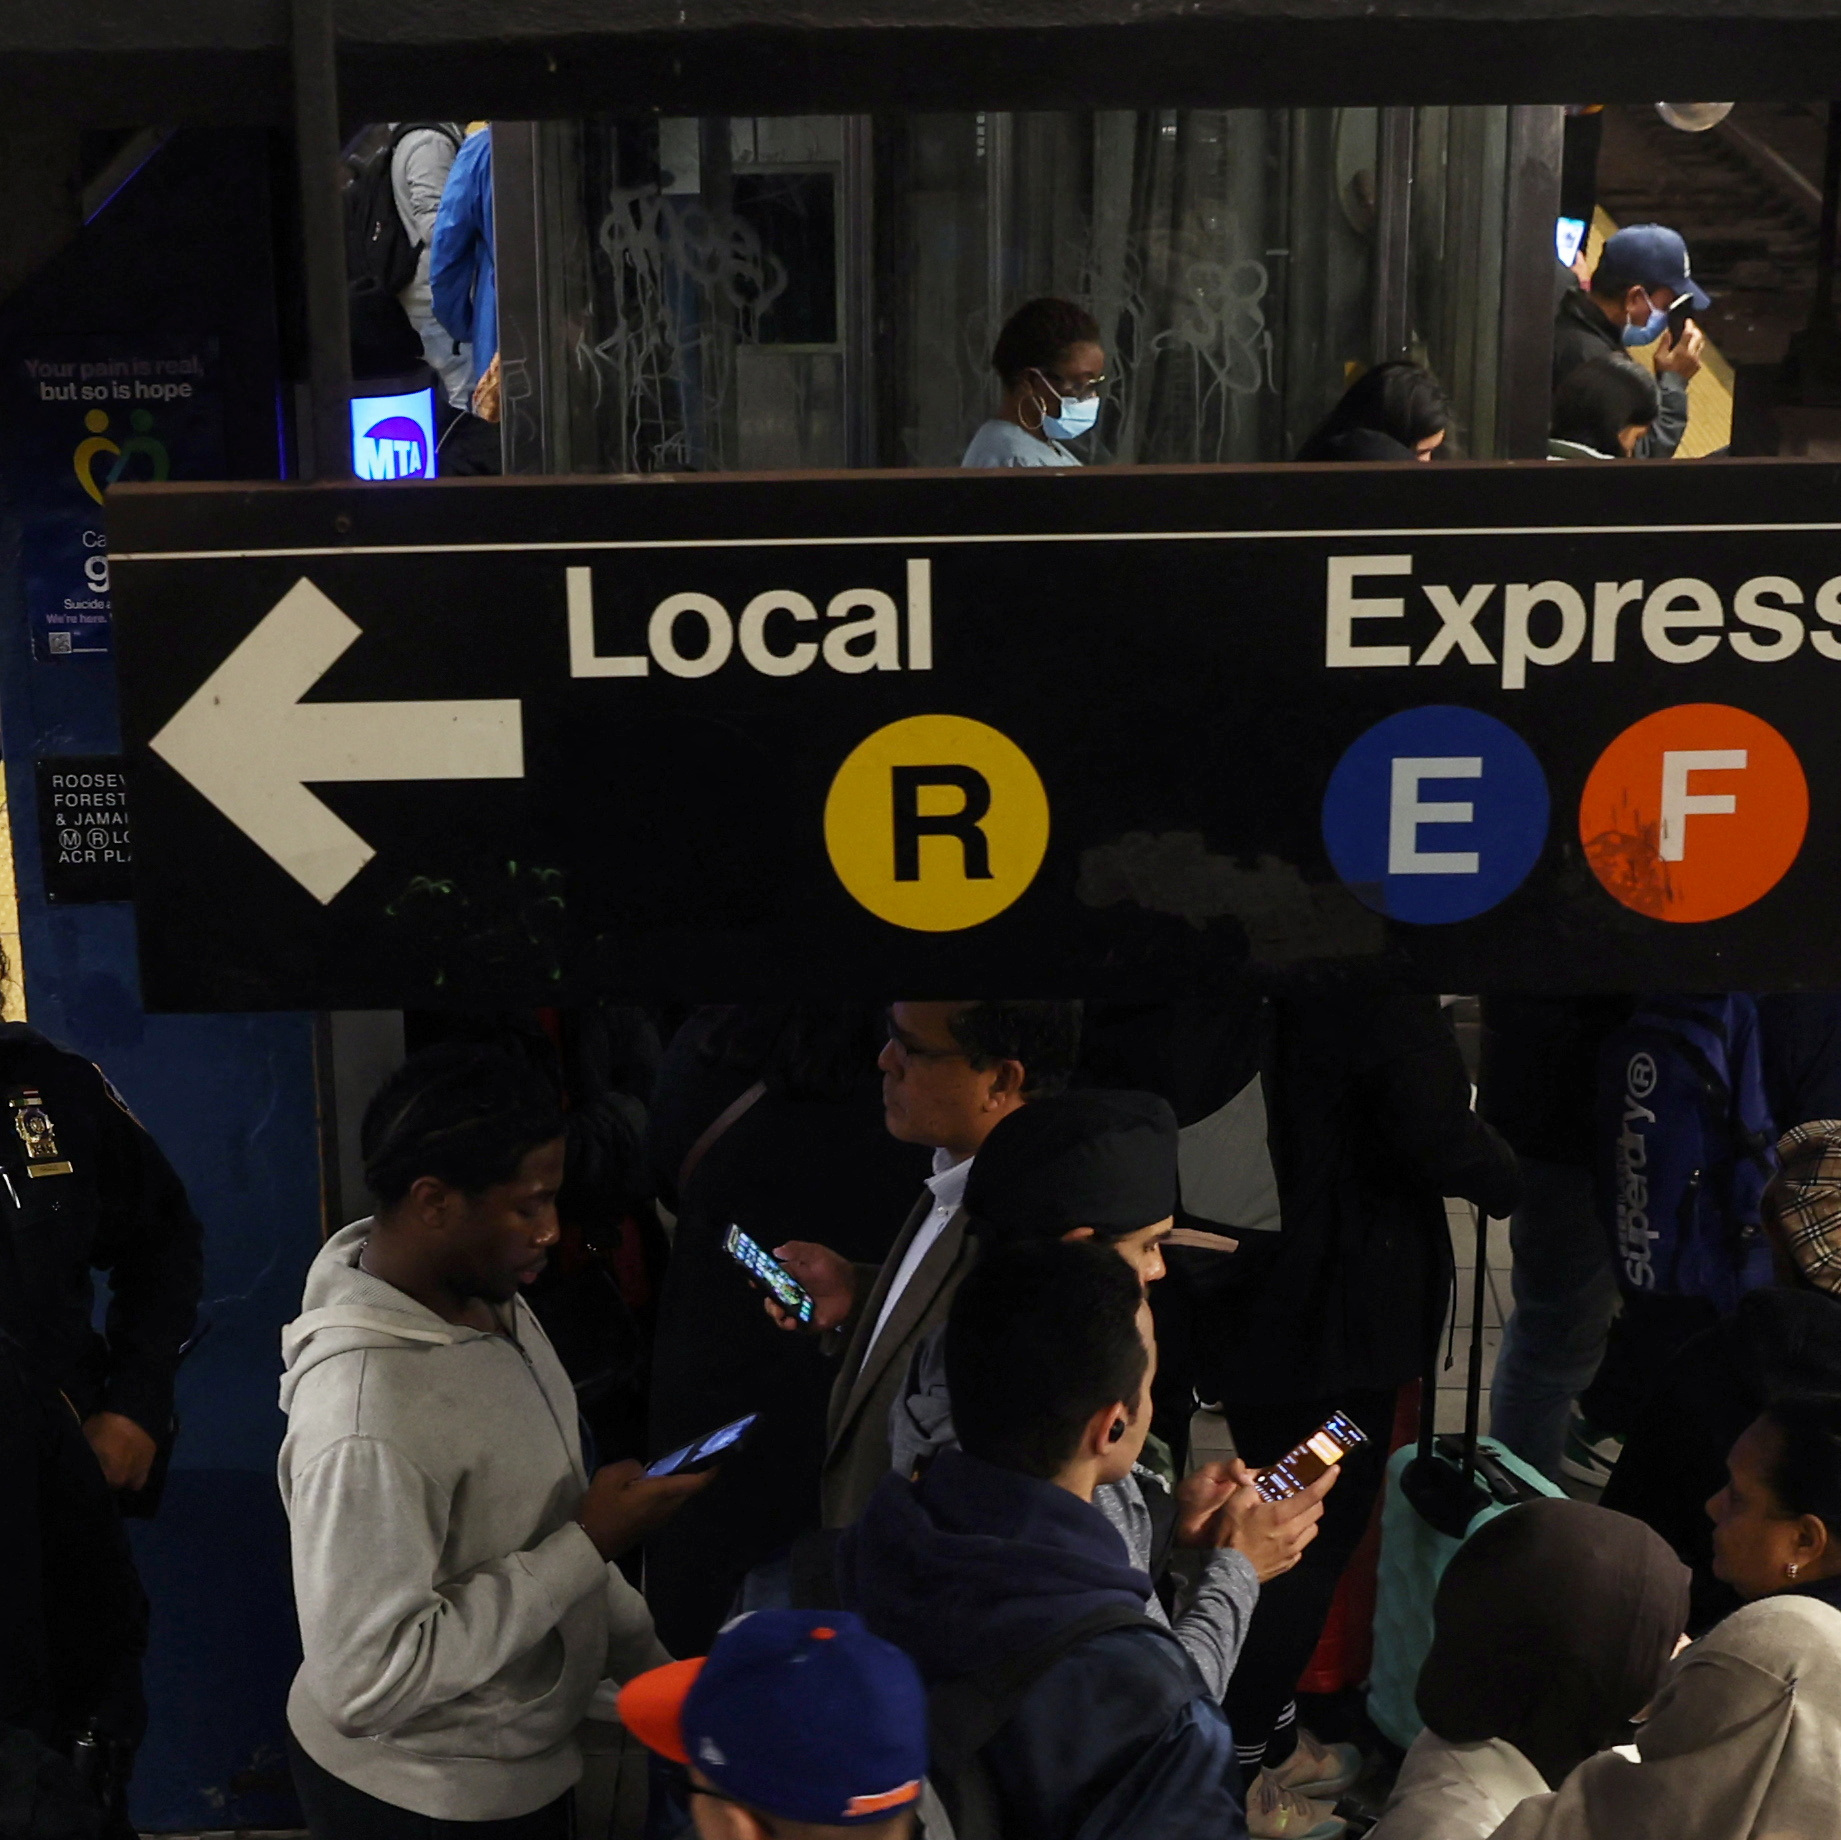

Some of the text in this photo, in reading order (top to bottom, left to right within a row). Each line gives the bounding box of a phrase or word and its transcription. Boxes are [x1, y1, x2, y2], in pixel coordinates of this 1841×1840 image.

[25, 355, 206, 381] Your pain is real,
[40, 380, 193, 402] but so is hope
[363, 437, 422, 480] MTA
[565, 557, 934, 679] Local
[55, 812, 129, 826] & JAMAI
[890, 764, 996, 883] R
[1388, 748, 1748, 875] E F
[58, 850, 132, 863] ACR PL
